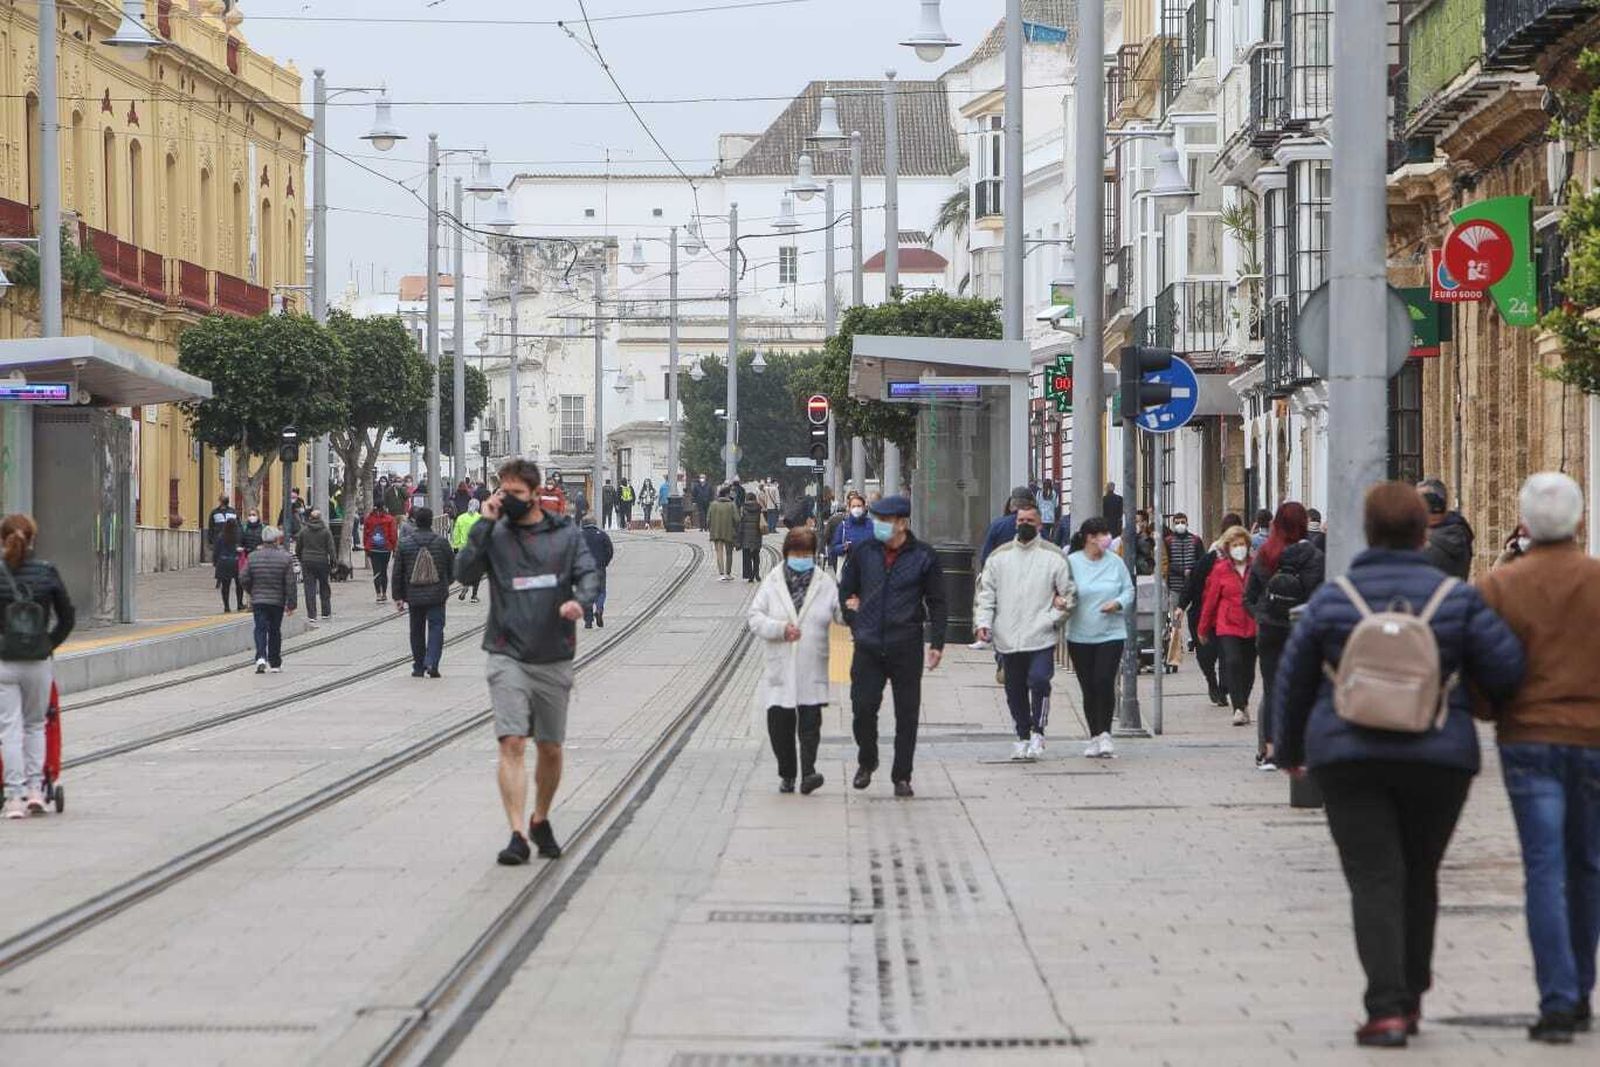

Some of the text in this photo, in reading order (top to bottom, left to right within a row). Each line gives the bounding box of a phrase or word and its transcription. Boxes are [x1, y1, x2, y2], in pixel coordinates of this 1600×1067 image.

[1434, 290, 1483, 299] EURO 6000
[1508, 298, 1529, 318] 24
